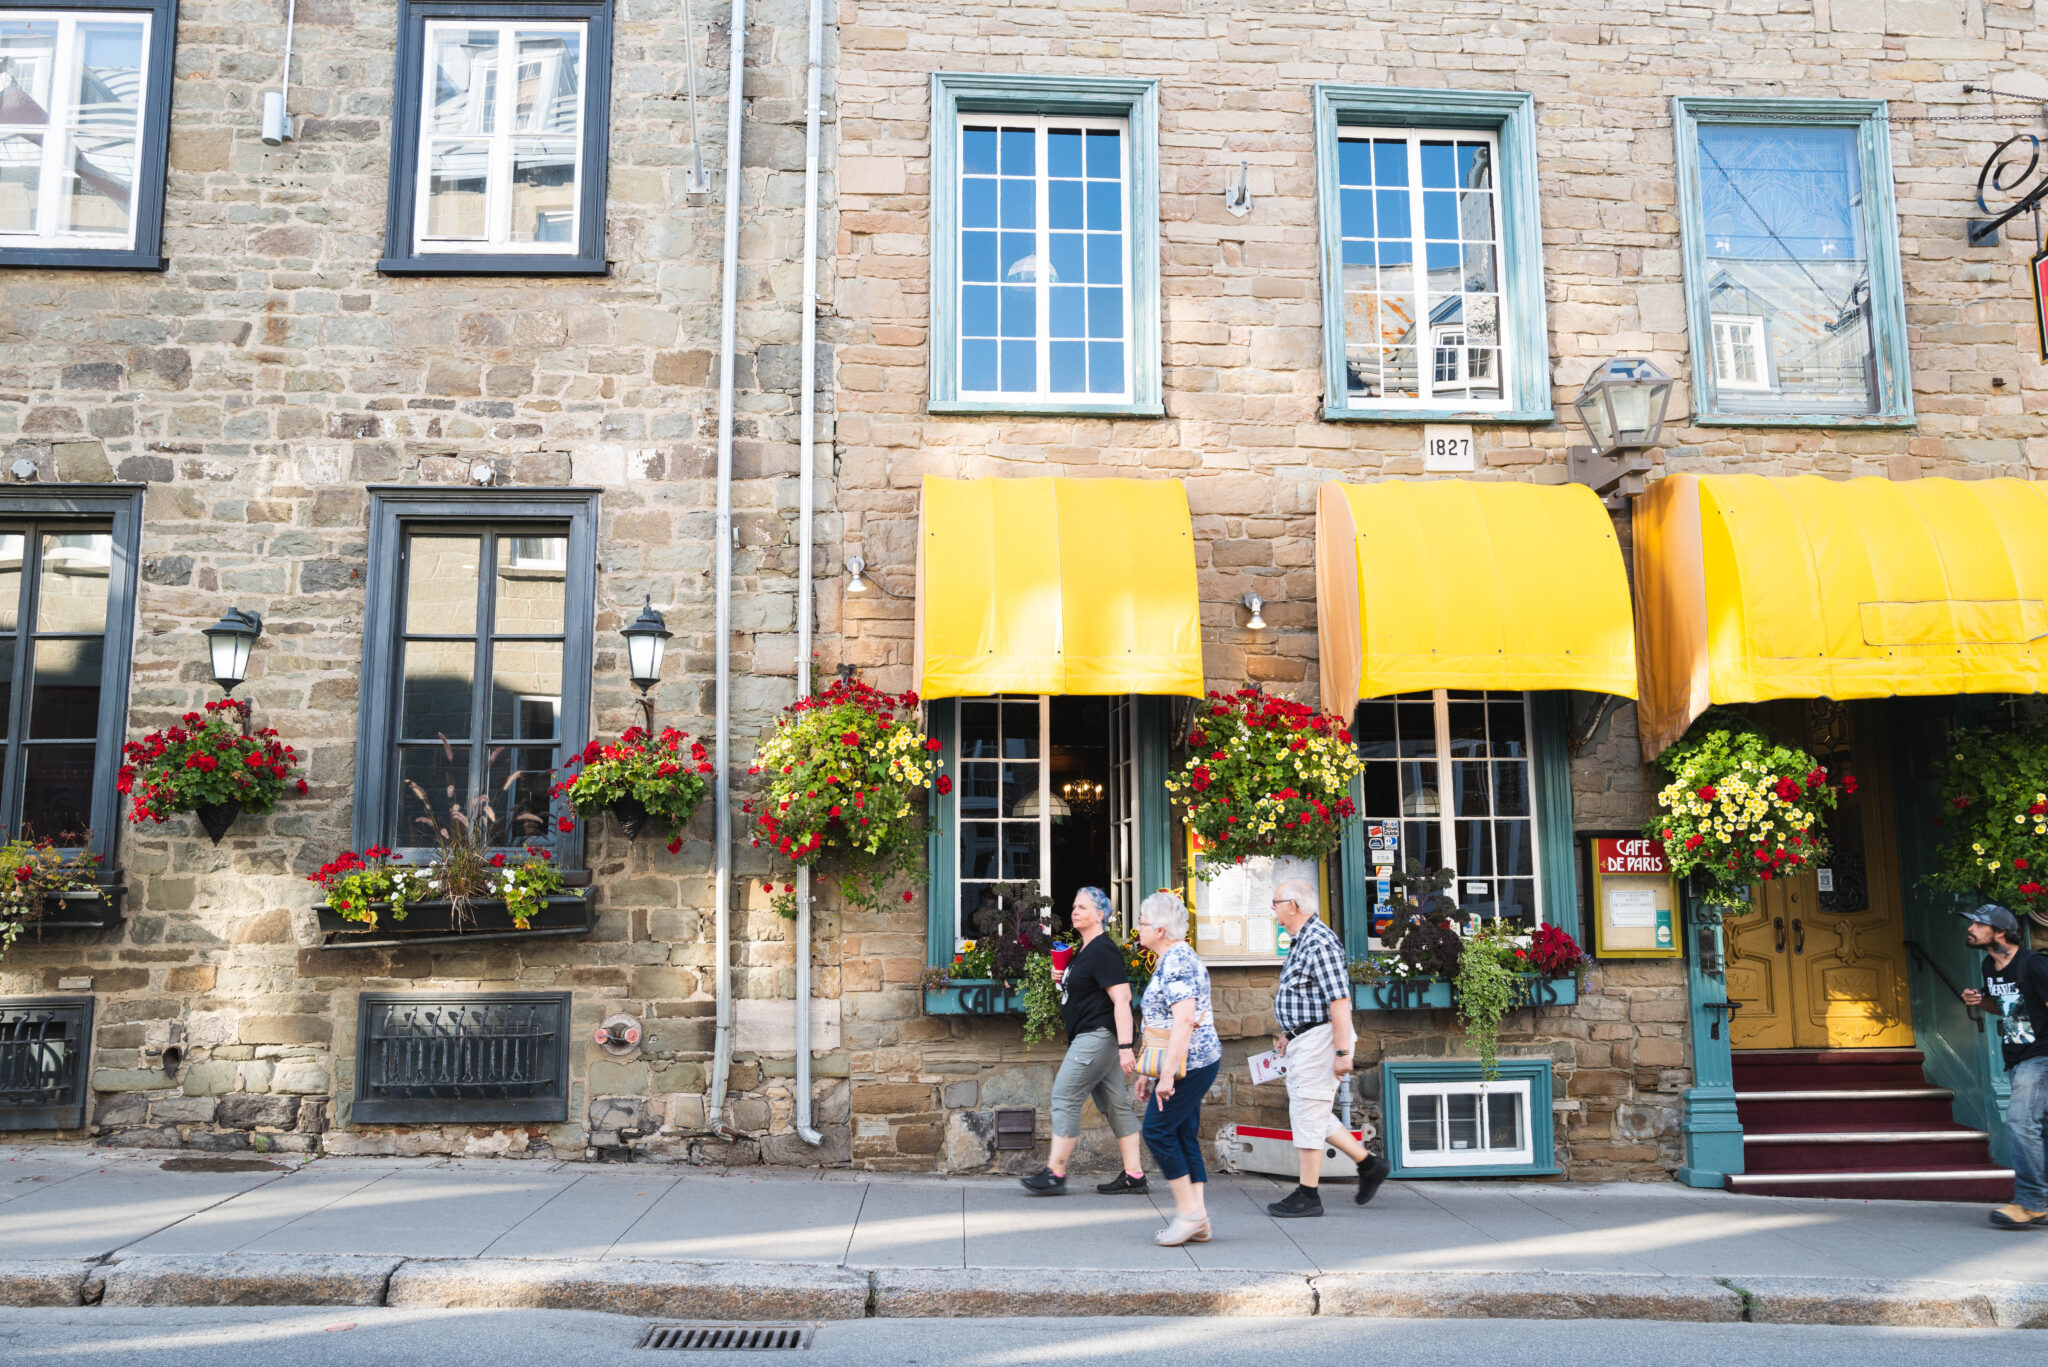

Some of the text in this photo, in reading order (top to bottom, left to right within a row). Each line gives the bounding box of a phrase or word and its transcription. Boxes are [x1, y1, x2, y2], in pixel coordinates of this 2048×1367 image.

[1430, 439, 1469, 456] 1827
[1607, 857, 1663, 872] DE PARIS
[1376, 905, 1393, 913] VISA
